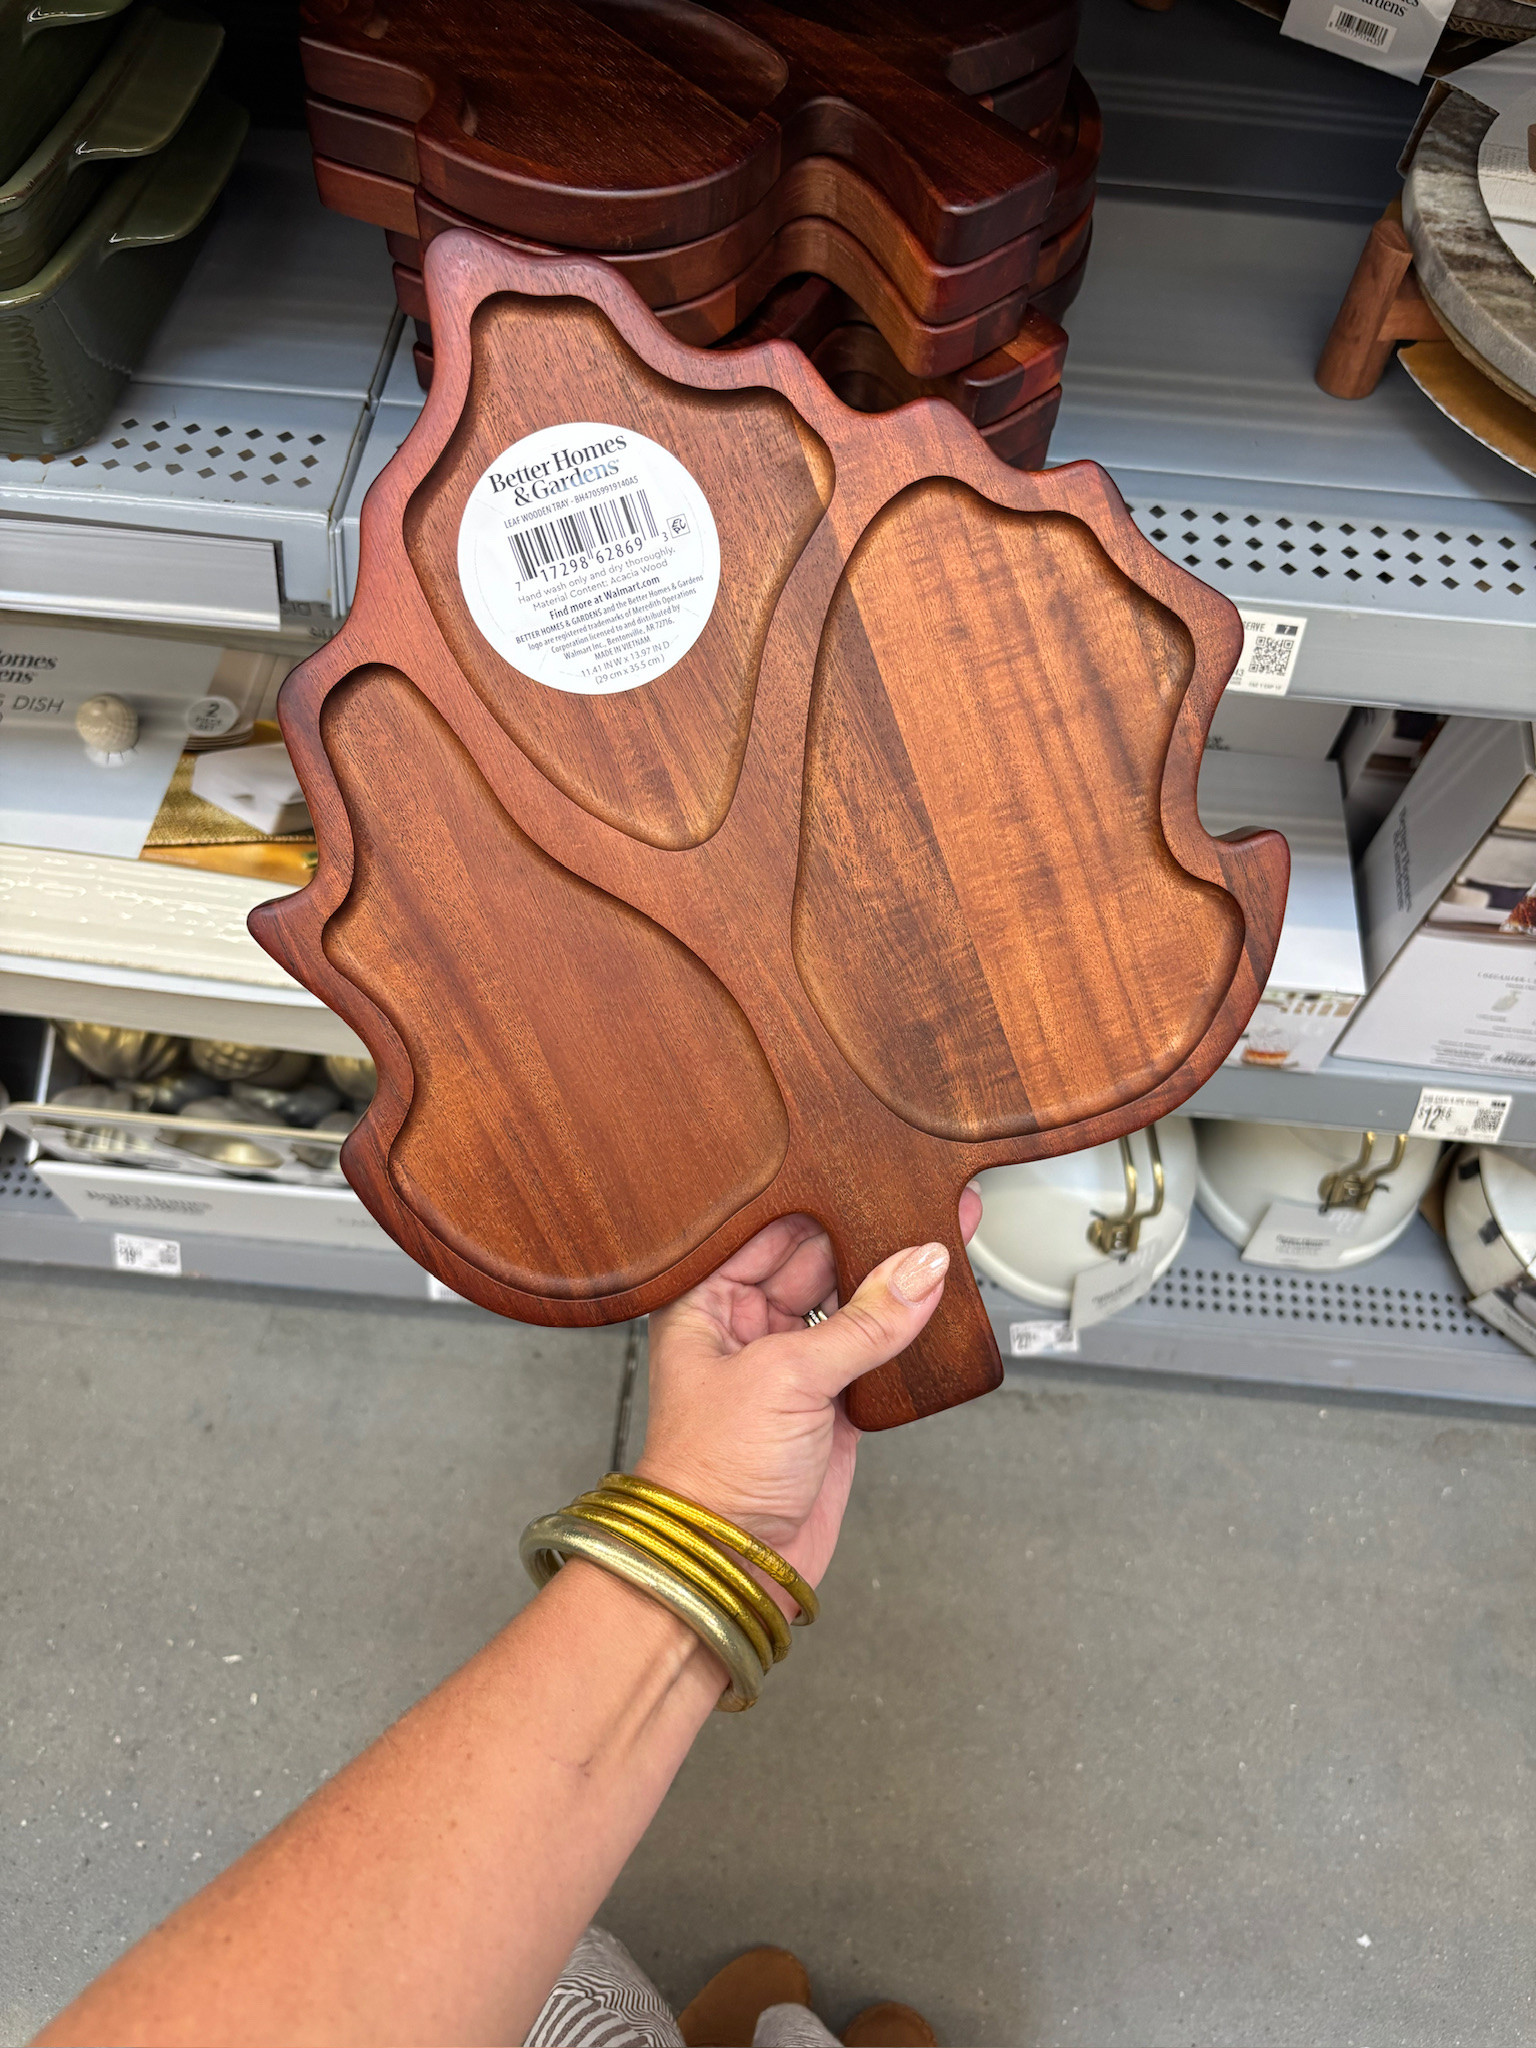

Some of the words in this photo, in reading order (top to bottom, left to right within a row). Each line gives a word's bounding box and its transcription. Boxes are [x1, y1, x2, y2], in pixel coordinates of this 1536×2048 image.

[488, 460, 550, 493] Better
[551, 435, 626, 471] Homes
[514, 486, 531, 506] &
[531, 458, 619, 499] Gardens
[503, 515, 520, 528] LEAF
[520, 504, 552, 522] WOODEN
[551, 498, 569, 511] TRAY
[514, 581, 520, 591] 7
[539, 555, 588, 582] 17298
[595, 536, 642, 564] 62869
[661, 531, 668, 542] 3
[517, 588, 542, 604] Hand
[543, 581, 566, 595] wash
[568, 575, 587, 587] only
[589, 567, 606, 580] and
[608, 563, 623, 573] dry
[624, 545, 675, 568] thoroughly.
[532, 591, 568, 611] Material
[569, 580, 608, 598] Content:
[610, 569, 639, 584] Acacia
[639, 558, 668, 573] Wood
[515, 629, 540, 644] BETTER
[540, 621, 564, 635] HOMES
[564, 619, 571, 627] &
[571, 607, 602, 625] GARDENS
[602, 603, 615, 614] and
[615, 600, 626, 609] the
[626, 593, 647, 605] Better
[647, 585, 671, 598] Homes
[670, 582, 676, 590] &
[676, 574, 703, 588] Gardens
[527, 641, 543, 650] logo
[543, 637, 554, 645] are
[554, 624, 587, 641] registered
[587, 612, 624, 630] trademarks
[624, 607, 631, 617] of
[631, 598, 661, 615] Meredith
[661, 587, 696, 604] Operations
[548, 604, 569, 620] Find
[569, 599, 592, 613] more
[593, 594, 603, 604] at
[602, 576, 660, 600] Walmart.com
[550, 636, 589, 653] Corporation
[587, 625, 615, 640] licensed
[623, 618, 636, 629] and
[636, 605, 672, 624] distributed
[670, 603, 680, 613] by
[563, 645, 592, 659] Walmart
[645, 622, 655, 632] AR
[594, 647, 613, 660] MADE
[612, 645, 621, 653] IN
[620, 635, 650, 650] VIETNAM
[581, 664, 601, 677] 11.41
[603, 659, 613, 669] IN
[612, 656, 622, 666] W
[629, 646, 650, 659] 13.97
[651, 643, 662, 652] IN
[661, 640, 670, 649] D
[609, 670, 622, 679] cm
[628, 659, 646, 672] 35.5
[647, 656, 660, 666] cm
[12, 695, 64, 713] DISH
